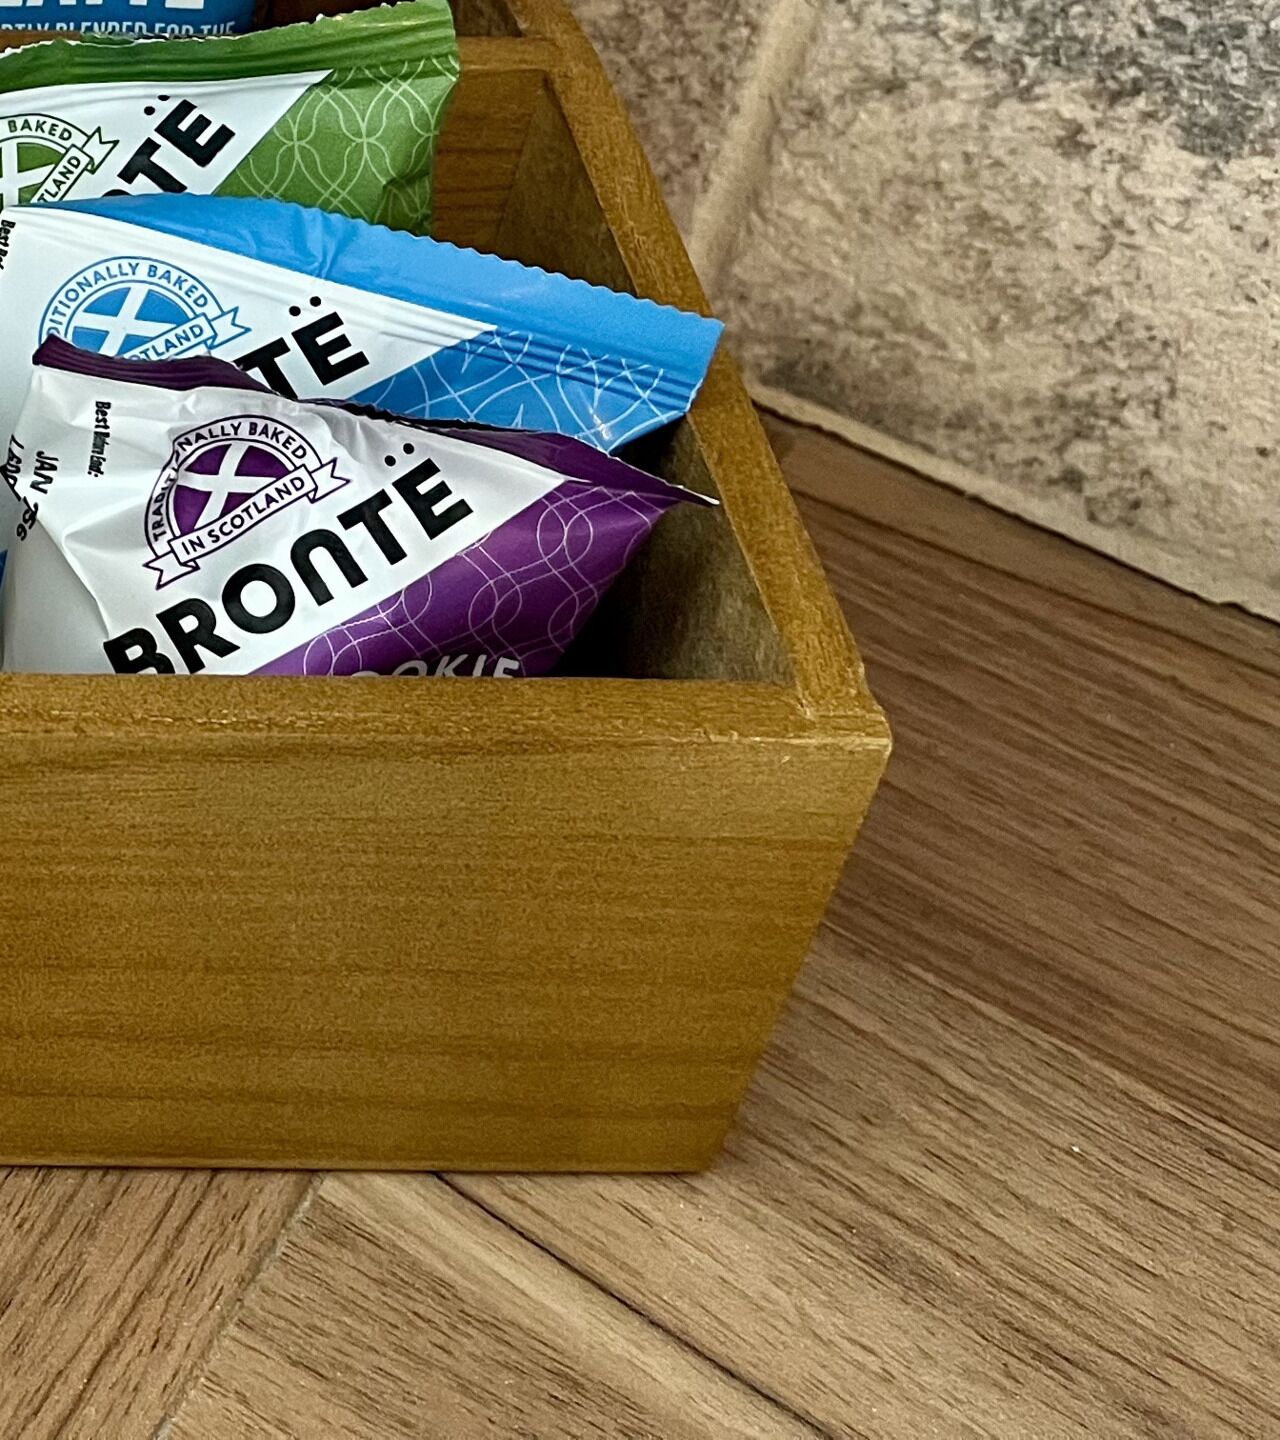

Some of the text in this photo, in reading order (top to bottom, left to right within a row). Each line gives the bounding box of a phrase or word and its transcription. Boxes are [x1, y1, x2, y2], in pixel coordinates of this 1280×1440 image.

[7, 119, 73, 142] BAKED
[147, 264, 209, 308] BAKED
[94, 400, 112, 430] Best
[248, 421, 308, 460] BAKED
[30, 450, 60, 495] JAN
[181, 475, 306, 556] IN SCOTLAND
